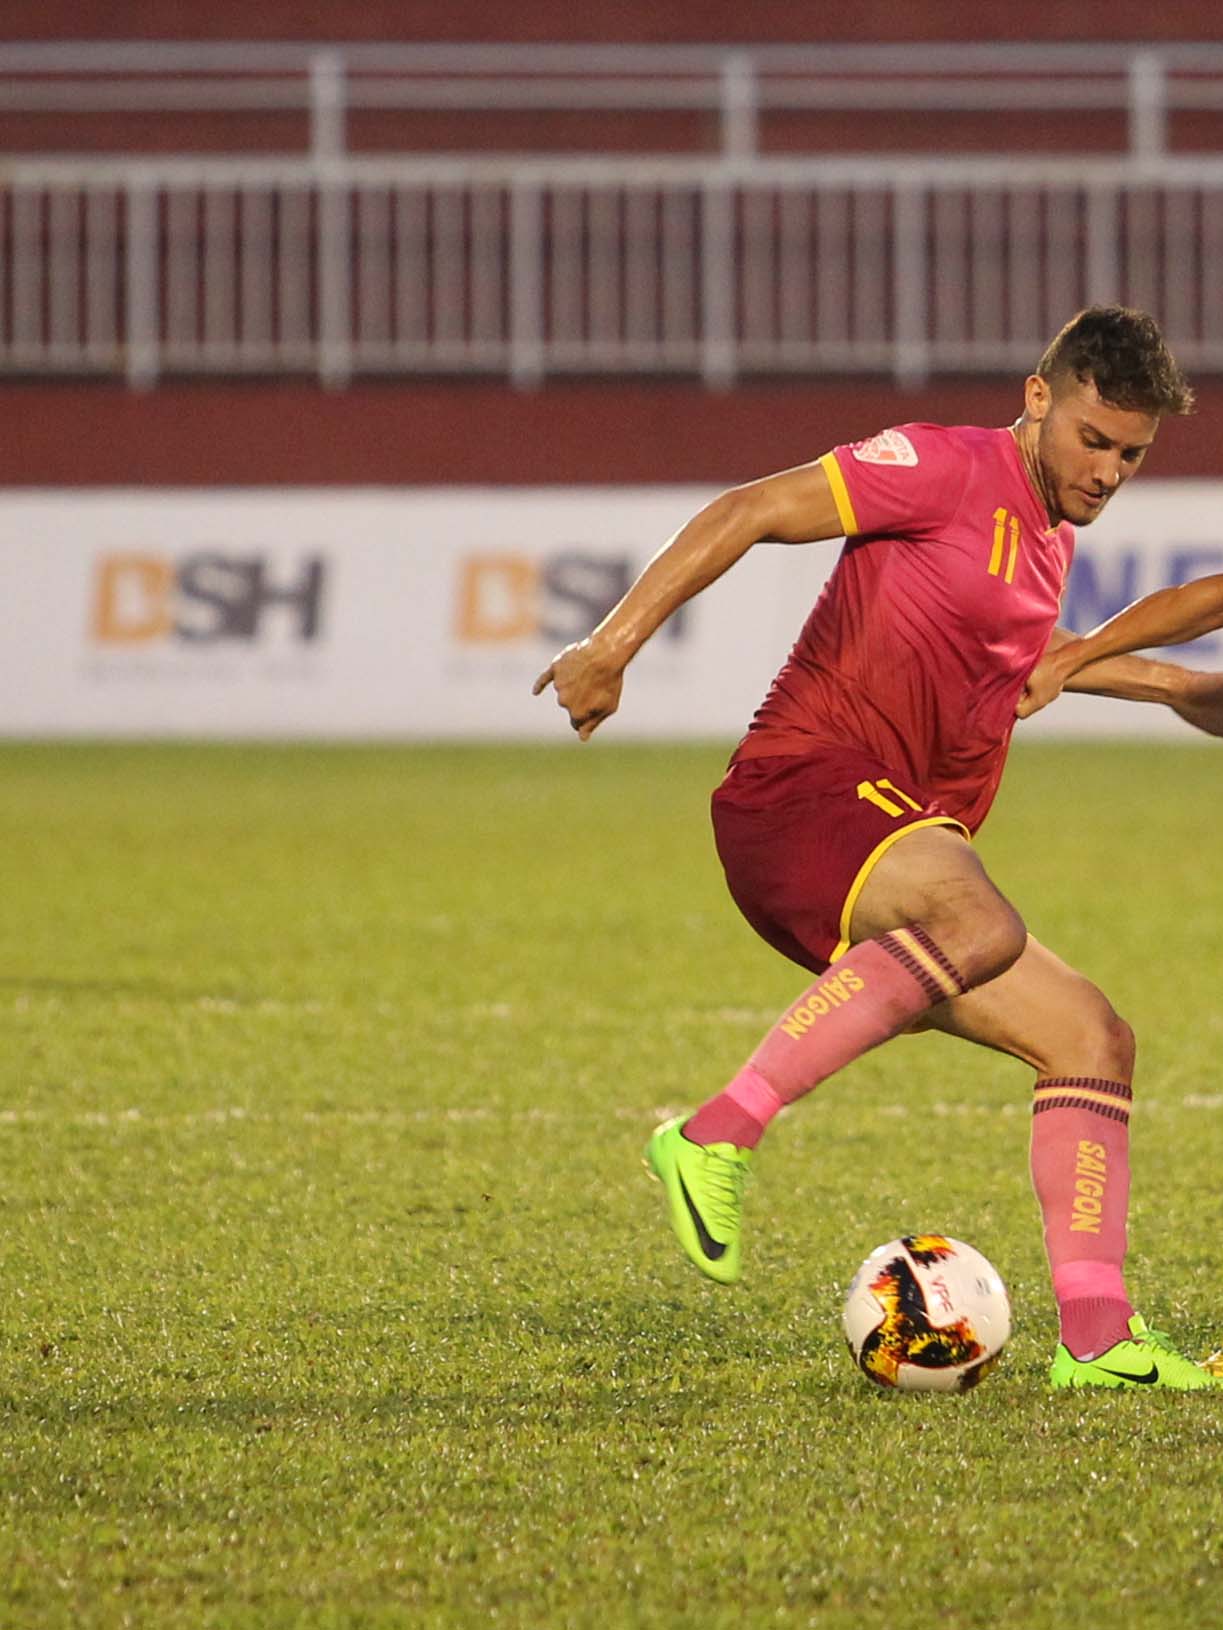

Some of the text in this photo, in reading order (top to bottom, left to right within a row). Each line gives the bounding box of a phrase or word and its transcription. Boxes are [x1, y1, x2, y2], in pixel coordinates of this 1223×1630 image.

[987, 506, 1021, 585] 11
[856, 778, 924, 818] 11
[780, 967, 866, 1041] SAIGON
[1069, 1139, 1107, 1235] SAIGON
